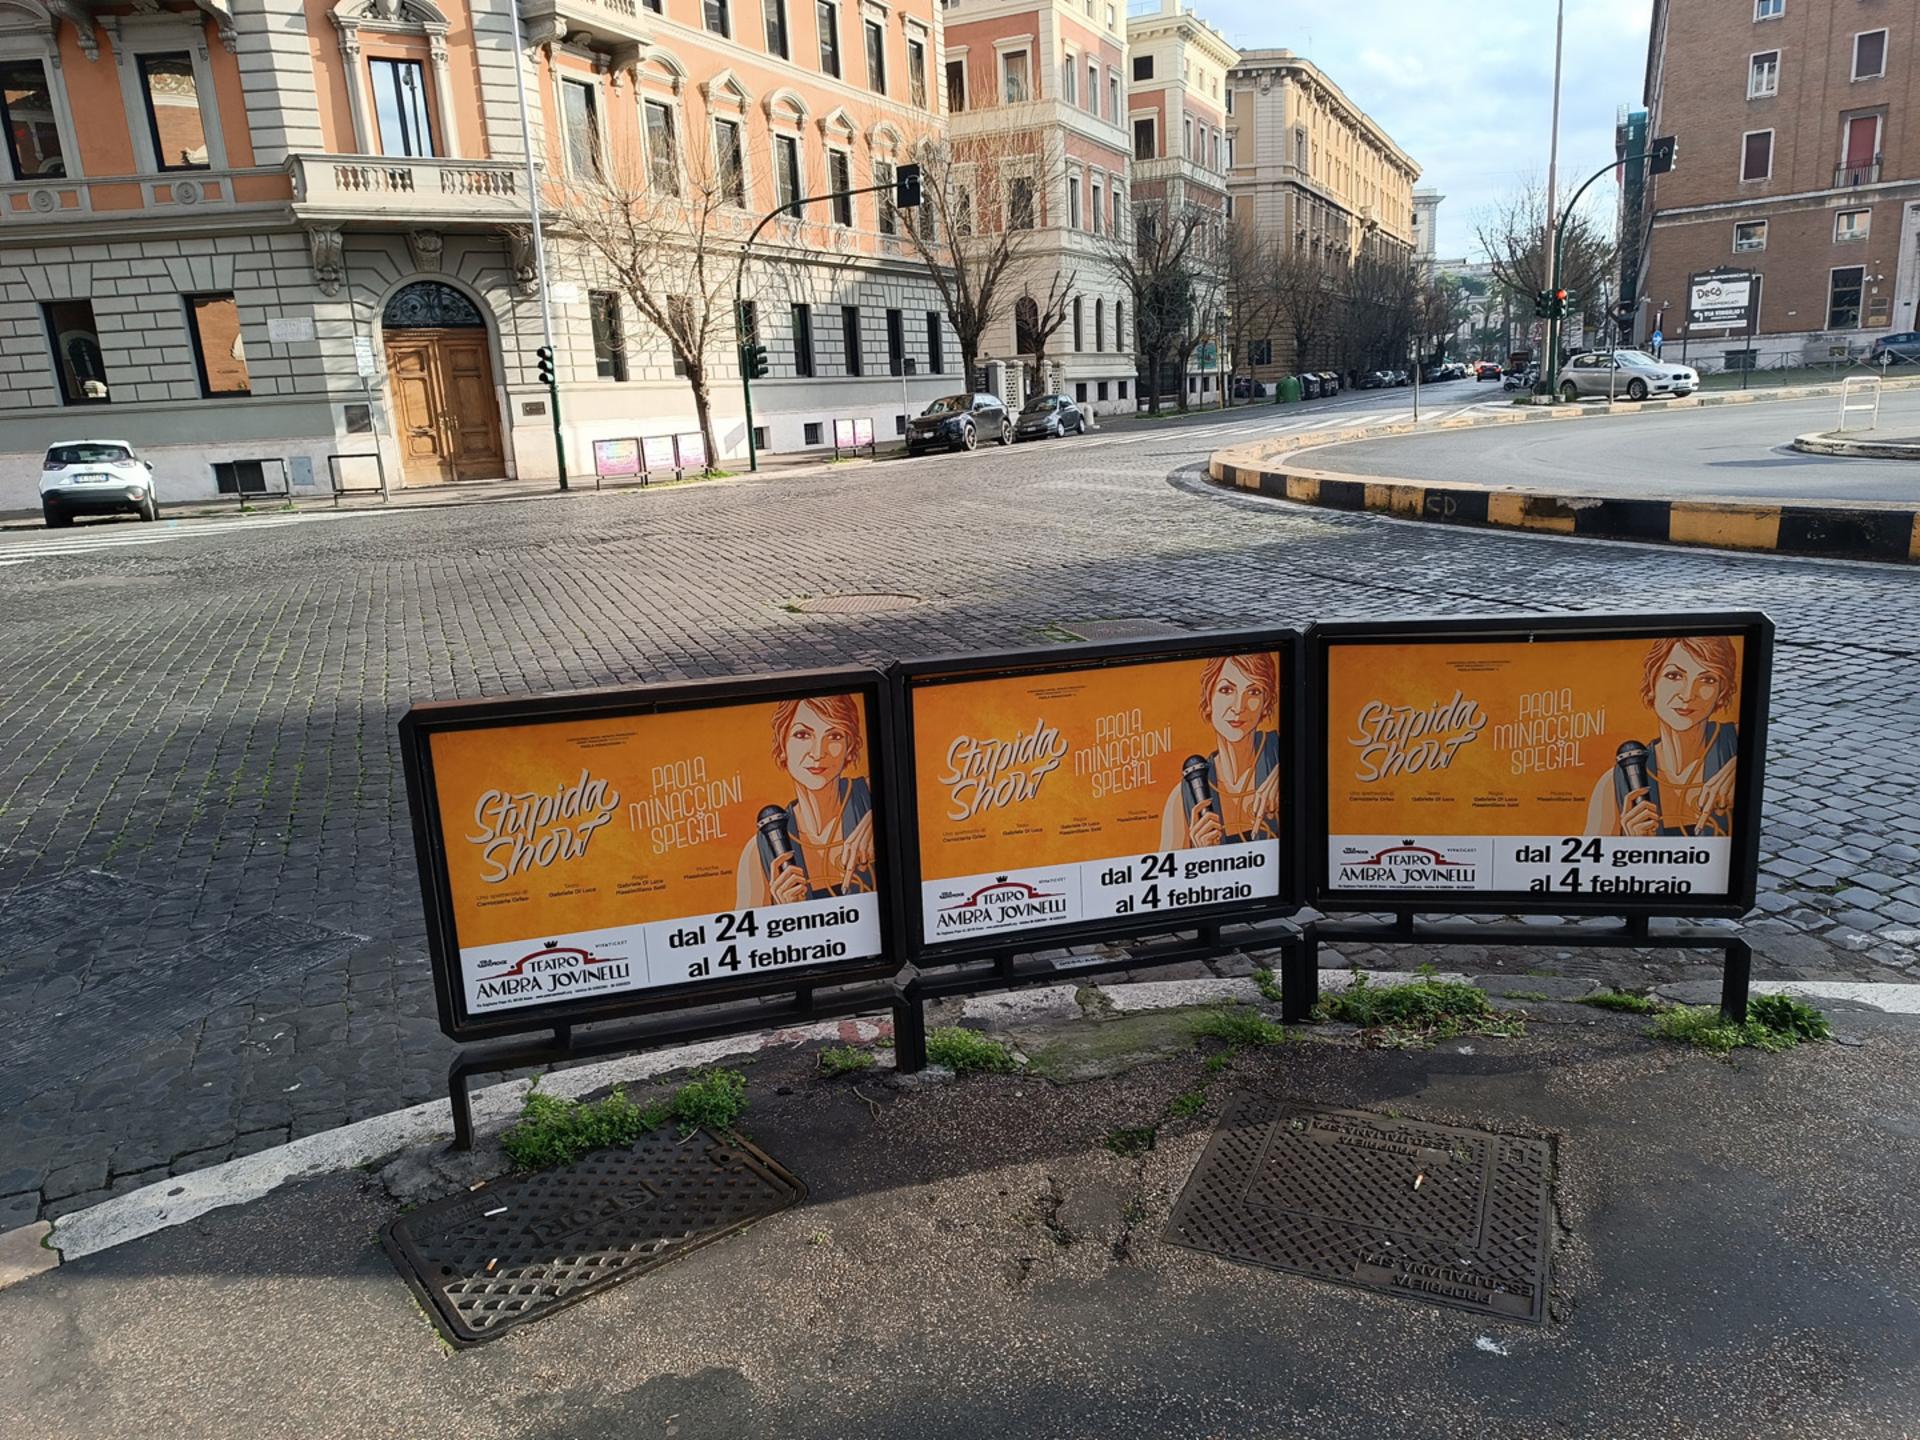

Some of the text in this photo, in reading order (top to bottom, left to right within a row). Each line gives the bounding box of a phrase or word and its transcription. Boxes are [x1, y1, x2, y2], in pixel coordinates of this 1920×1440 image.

[1347, 689, 1488, 749] Stupida
[1519, 687, 1572, 720] PAOLA
[1095, 708, 1144, 743] PAOLA
[937, 716, 1069, 785] Stupida
[1355, 731, 1478, 783] Show
[652, 756, 706, 795] PAOLA
[947, 758, 1061, 821] Show
[465, 768, 620, 843] Stupida
[480, 812, 612, 883] Show
[1386, 855, 1431, 865] TEATRO
[1515, 837, 1710, 867] dal 24 gennaio
[1101, 851, 1265, 886] dal 24 gennaio
[1338, 867, 1476, 884] AMBRA JOVINELLI
[1530, 867, 1692, 894] al 4 febbraio
[936, 908, 993, 928] AMBRA
[996, 898, 1066, 923] JOVINELLI
[982, 890, 1025, 905] TEATRO
[1115, 881, 1252, 914] al 4 febbraio
[668, 906, 860, 949] dal 24 gennaio
[529, 956, 579, 973] TEATRO
[688, 939, 846, 978] al 4 febbraio
[476, 963, 630, 1000] AMBRA JOVINELLI
